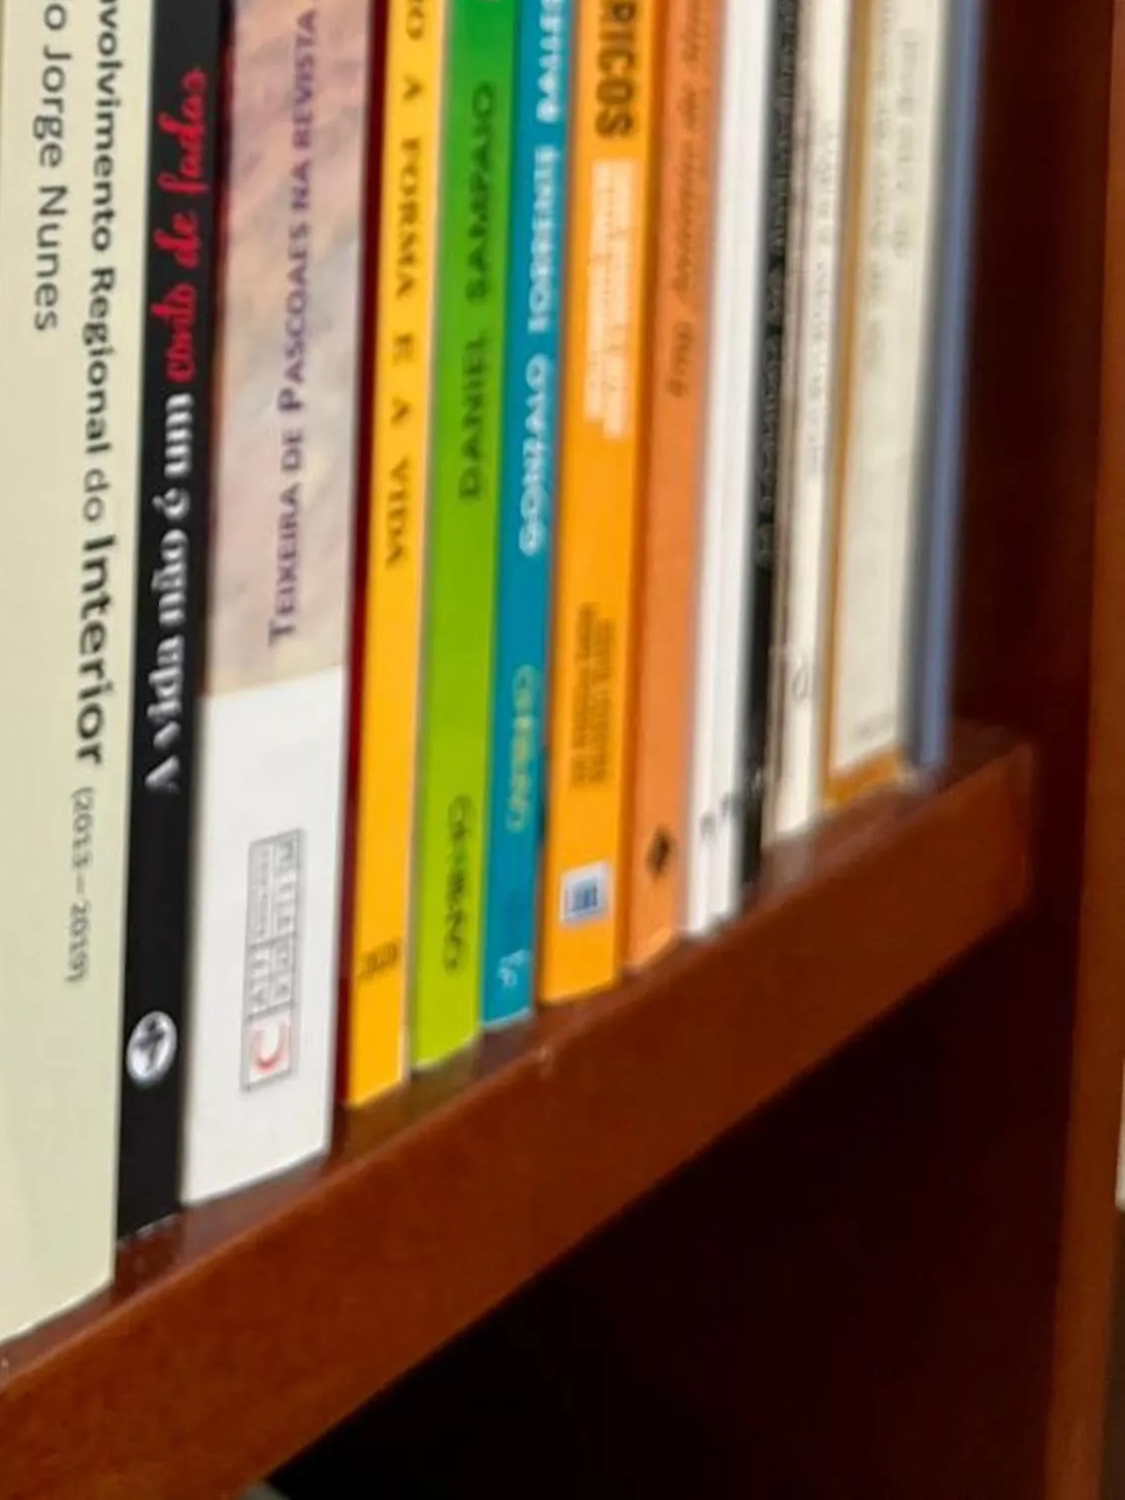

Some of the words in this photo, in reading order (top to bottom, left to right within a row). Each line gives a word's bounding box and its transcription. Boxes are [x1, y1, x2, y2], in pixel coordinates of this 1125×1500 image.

[32, 44, 72, 167] Jorge
[157, 68, 207, 194] fadas
[155, 213, 198, 268] de
[465, 80, 496, 304] SAMPAIO
[33, 186, 67, 331] Nunes
[81, 266, 116, 455] Regional
[152, 282, 197, 381] conto
[164, 393, 194, 478] um
[458, 329, 487, 501] DANIEL
[518, 353, 549, 556] GONZALO
[82, 467, 110, 523] do
[152, 488, 190, 520] é
[152, 530, 187, 626] não
[76, 534, 116, 766] Interior
[148, 636, 184, 751] vida
[146, 755, 178, 790] A
